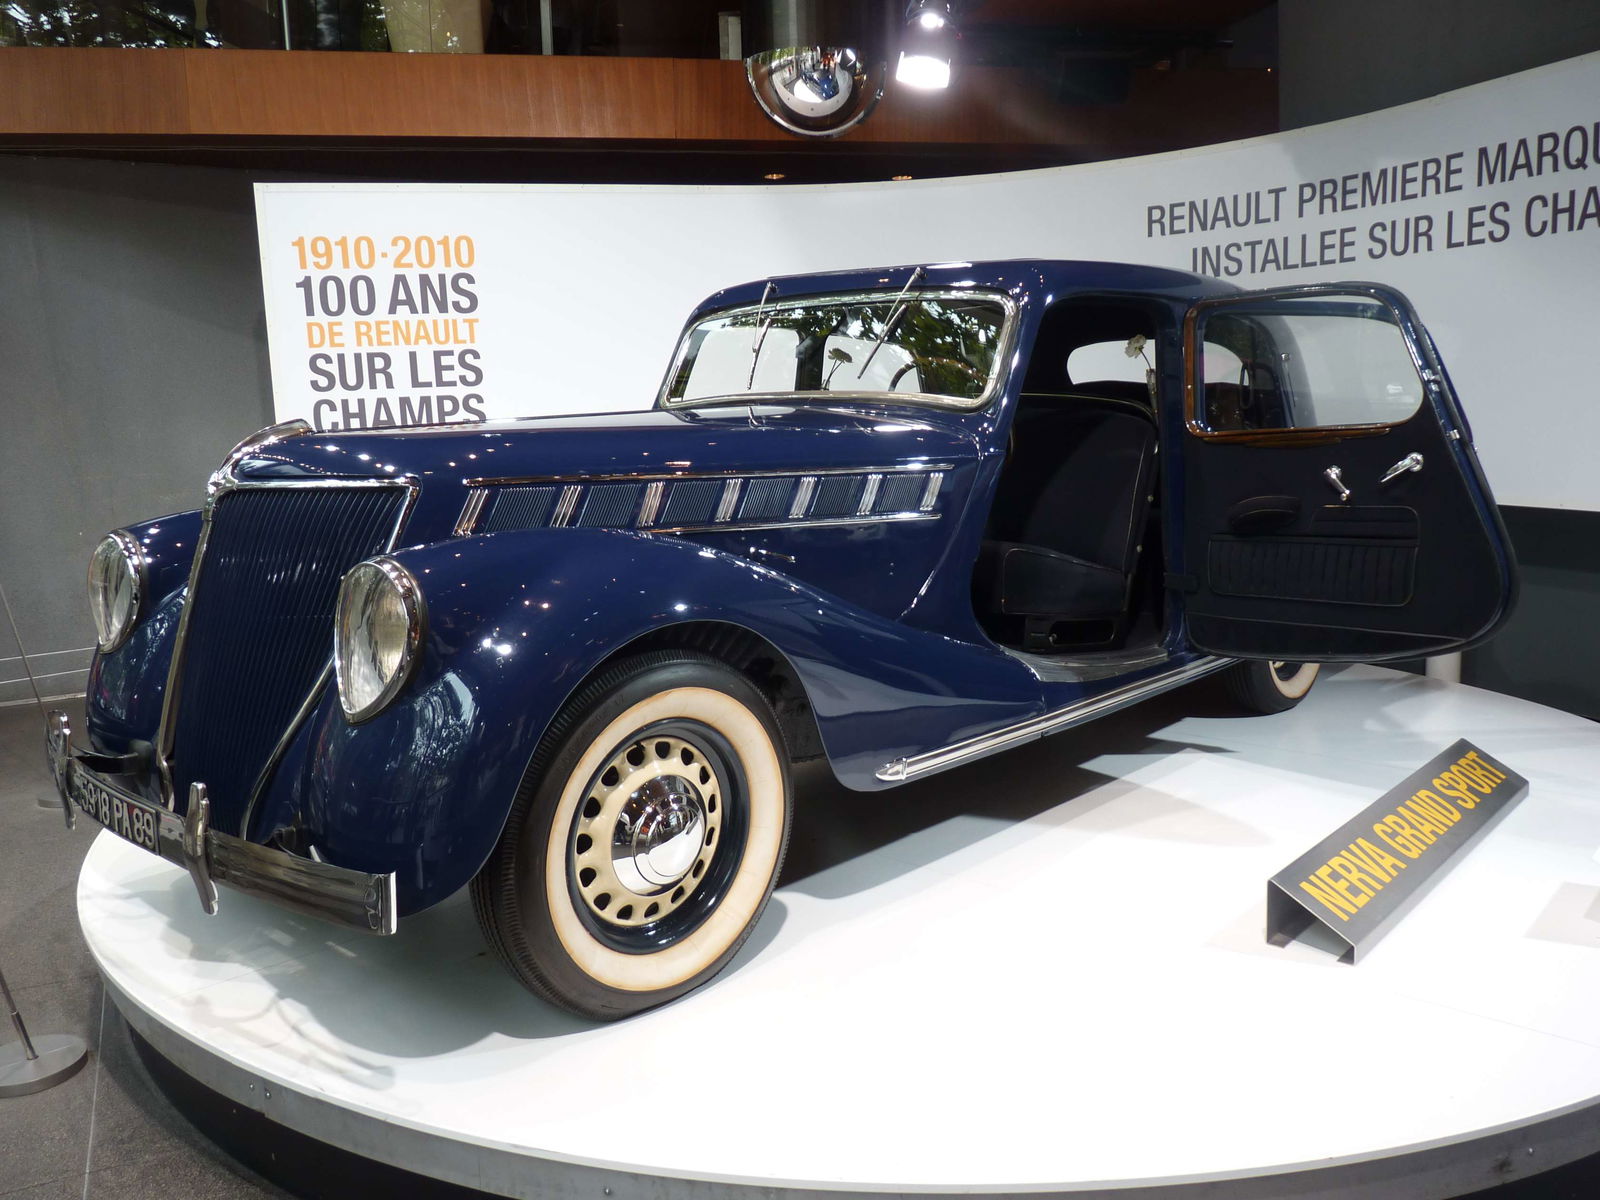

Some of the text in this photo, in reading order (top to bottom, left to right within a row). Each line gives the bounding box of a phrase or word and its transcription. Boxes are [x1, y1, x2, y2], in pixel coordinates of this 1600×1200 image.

[1146, 186, 1288, 238] RENAULT
[1298, 151, 1465, 219] PREMIERE
[1190, 226, 1357, 279] INSTALLEE
[1367, 214, 1433, 260] SUR
[1446, 201, 1511, 249] LES
[295, 272, 479, 317] 100 ANS
[306, 318, 480, 349] DE RENAULT
[308, 348, 484, 392] SUR LES
[312, 393, 487, 433] CHAMPS
[1299, 750, 1507, 922] NERVA GRAND SPORT
